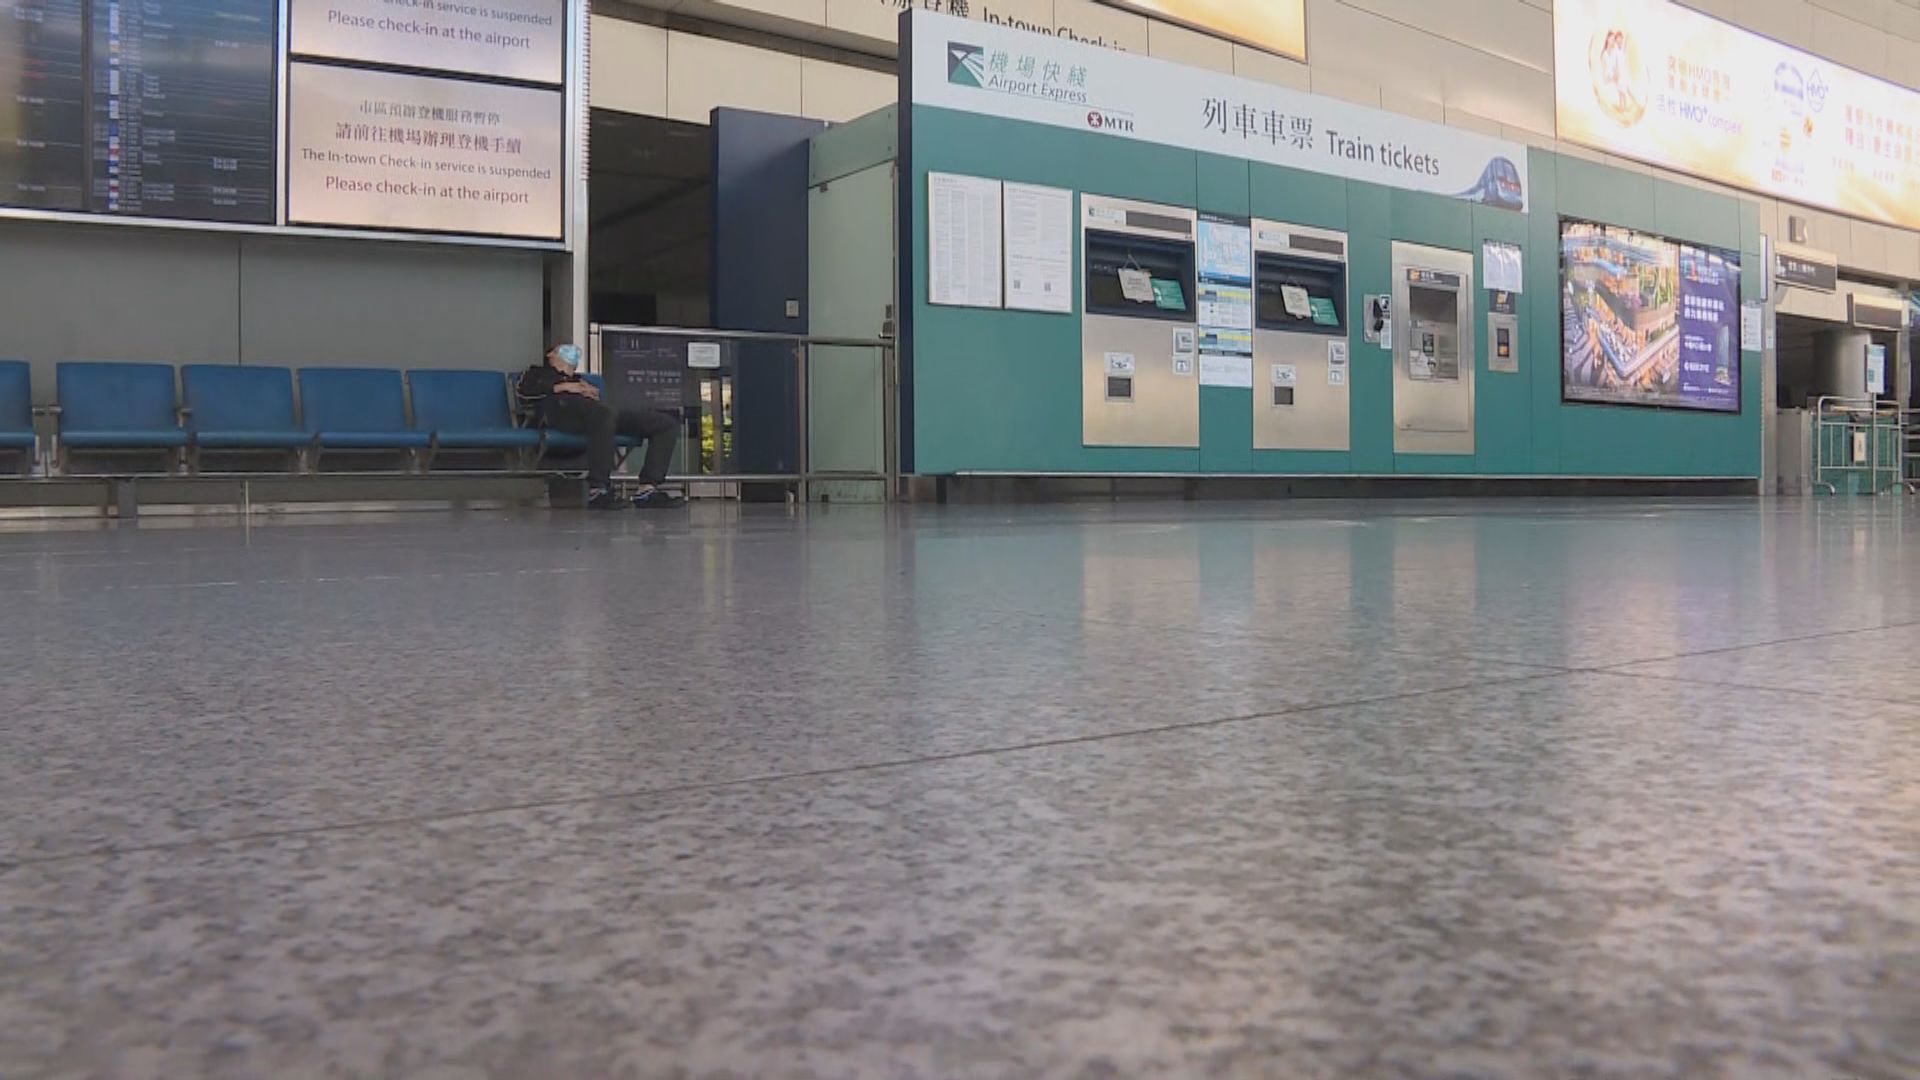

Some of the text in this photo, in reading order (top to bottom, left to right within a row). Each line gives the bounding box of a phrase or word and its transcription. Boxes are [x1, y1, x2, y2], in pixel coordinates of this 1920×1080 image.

[327, 10, 530, 49] Please check-in at the airport
[436, 2, 477, 15] service
[479, 7, 489, 17] is
[491, 9, 552, 26] suspended
[988, 74, 1088, 103] Airport Express
[335, 121, 522, 154] 請前往機場辦理登機手續
[1104, 115, 1135, 133] MTR
[1202, 97, 1440, 175] 列車車票 Train tickets
[302, 147, 551, 180] The In-town Check-in service is suspended
[326, 175, 529, 204] Please check-in at the airport
